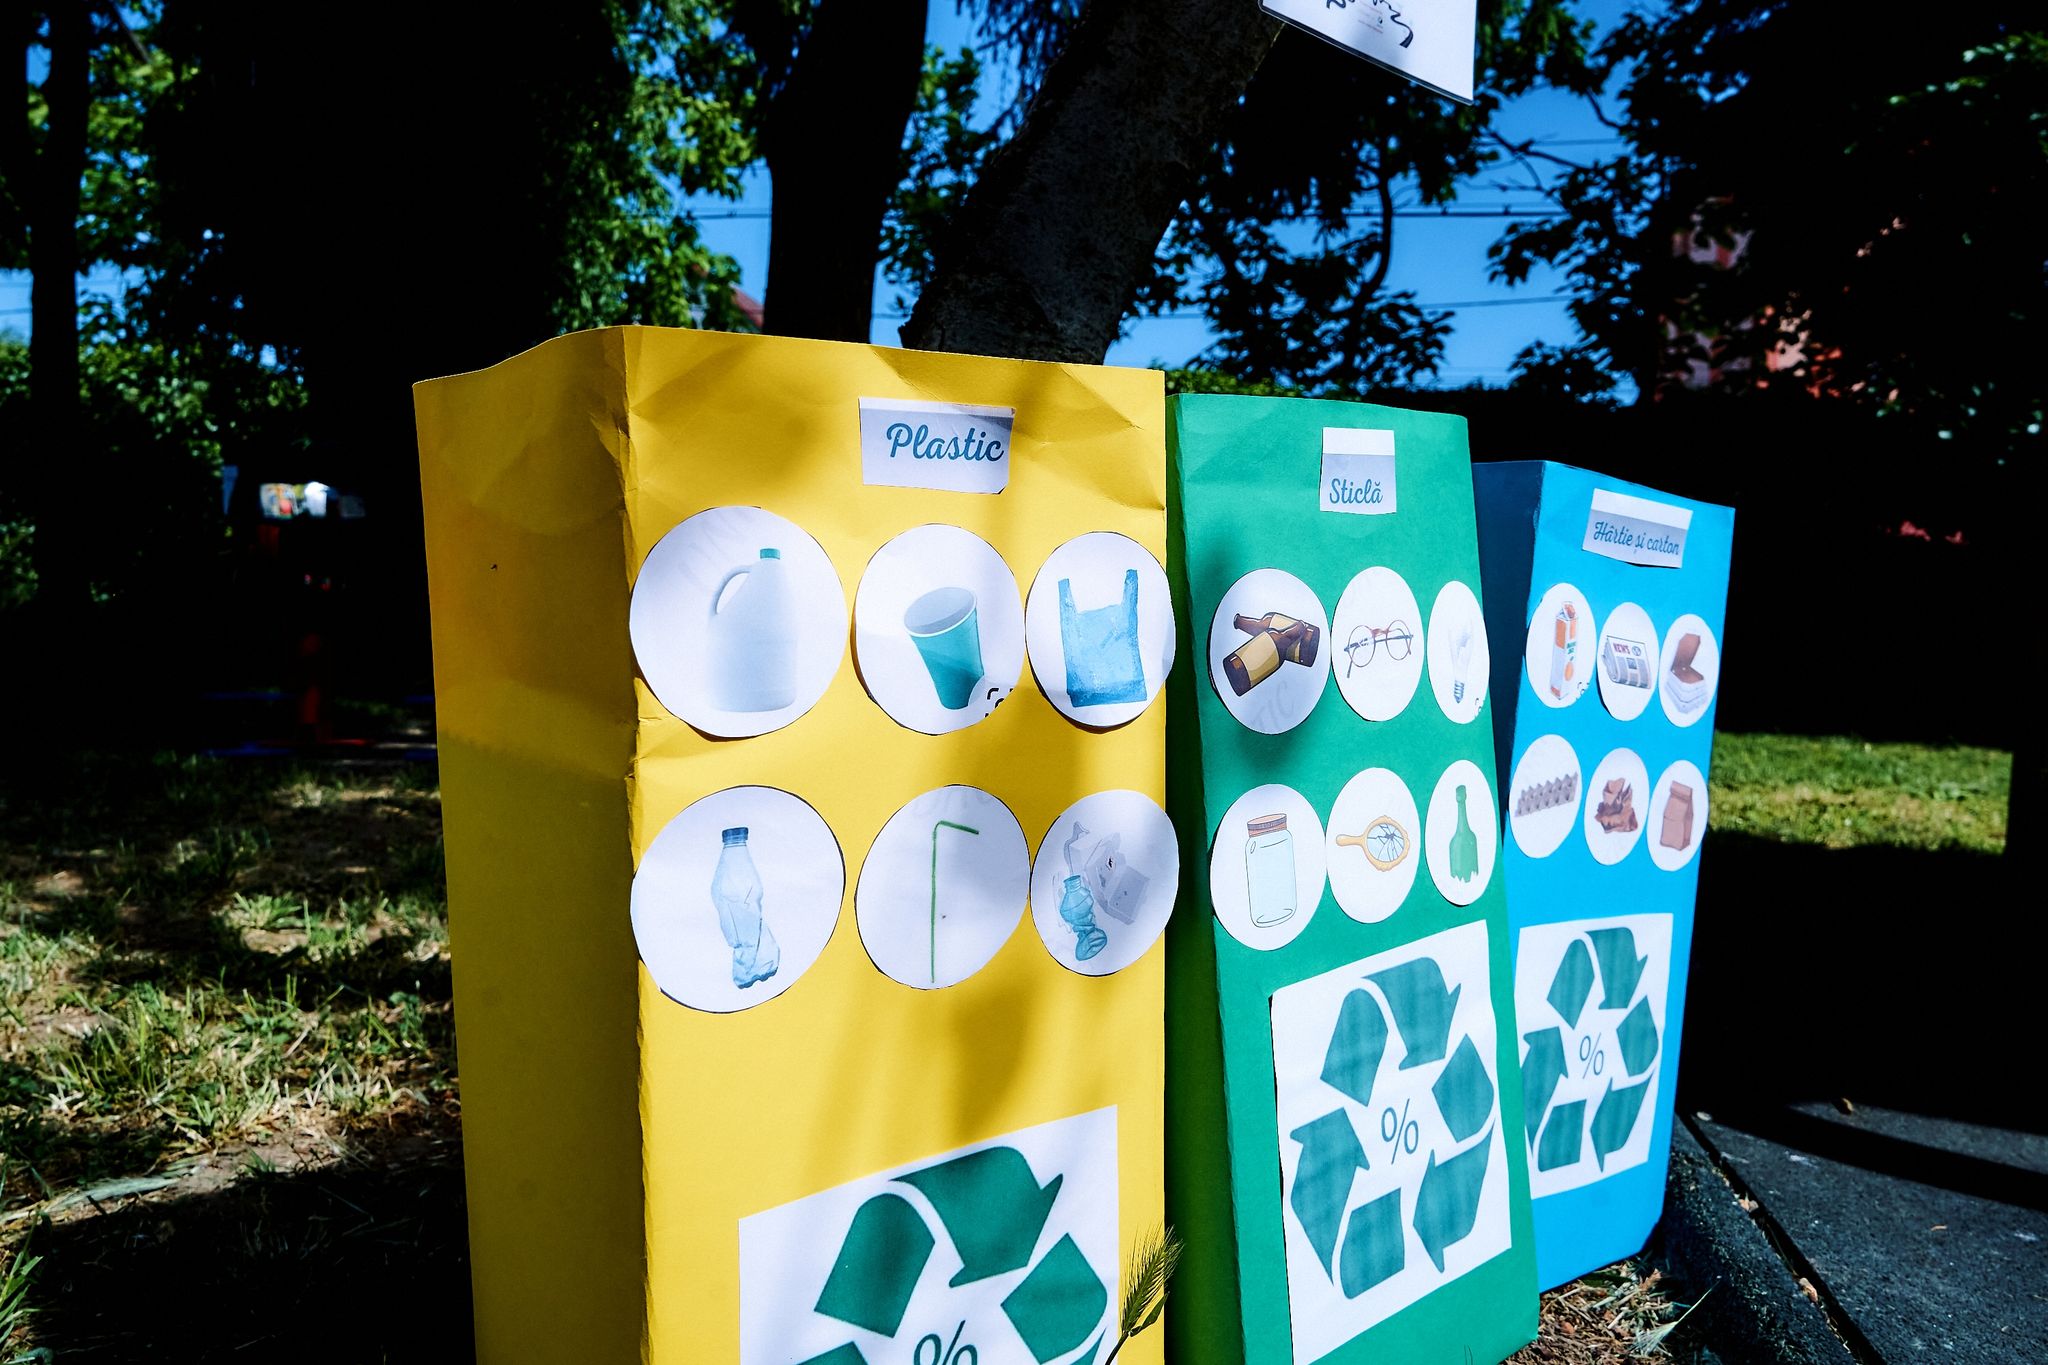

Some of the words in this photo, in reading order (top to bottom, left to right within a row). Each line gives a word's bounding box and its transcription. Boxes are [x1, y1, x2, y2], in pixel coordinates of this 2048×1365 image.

[886, 423, 1004, 462] Plastic
[1329, 478, 1383, 504] Sticlă
[1593, 521, 1633, 546] Hârtie
[1646, 535, 1680, 555] carton
[1580, 1032, 1604, 1079] %
[1381, 1098, 1419, 1165] %
